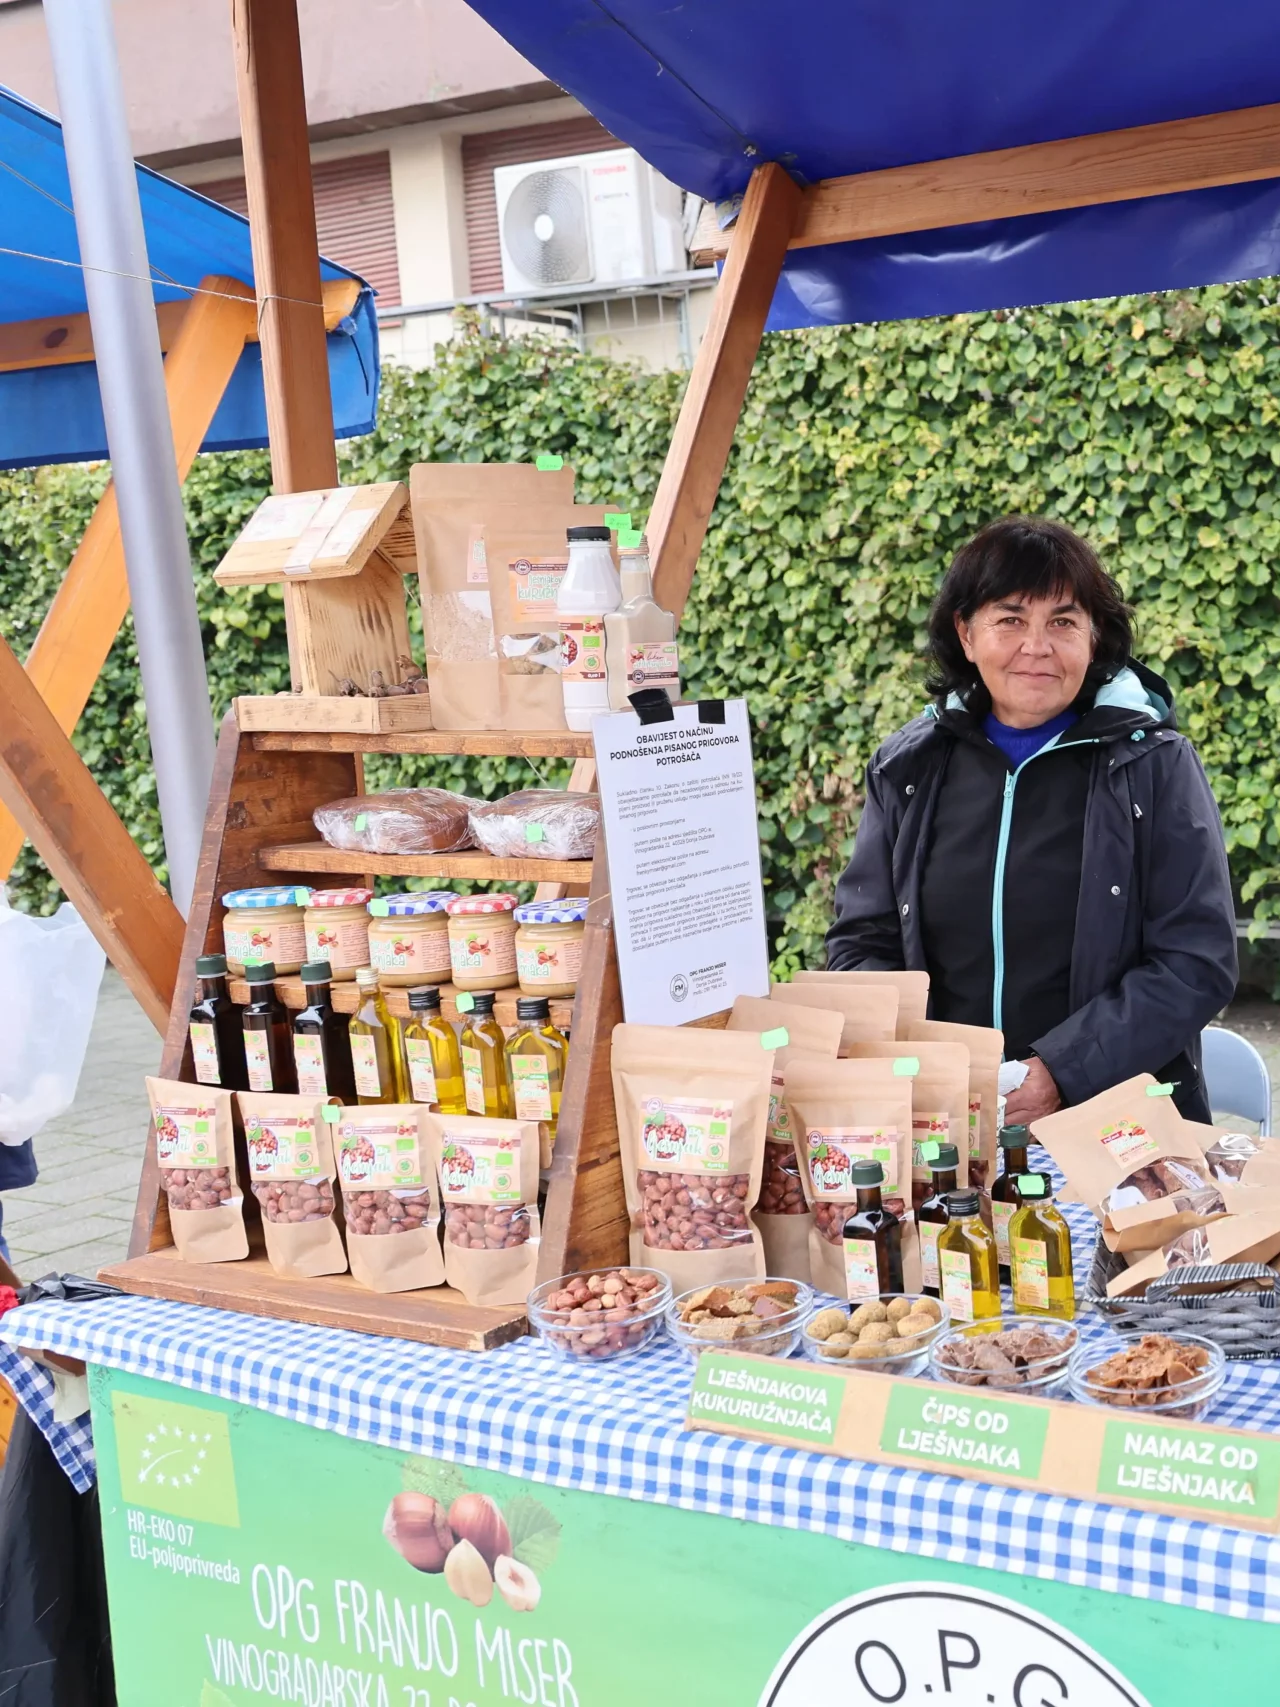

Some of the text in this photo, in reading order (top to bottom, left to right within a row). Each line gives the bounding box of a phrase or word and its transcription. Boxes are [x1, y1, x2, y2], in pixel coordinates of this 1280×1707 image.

[610, 735, 740, 761] PODNOŠENJA PISANOG PRIGOVORA
[636, 726, 714, 744] OBAVIJEST O NAČINU
[656, 752, 702, 766] POTROŠAČA
[707, 1367, 828, 1407] LJEŠNJAKOVA
[692, 1391, 832, 1435] KUKURUŽNJAČA
[922, 1396, 1009, 1435] ČIPS OD
[897, 1427, 1021, 1470] LJEŠNJAKA
[1124, 1432, 1258, 1471] NAMAZ OD
[1117, 1464, 1256, 1506] LJEŠNJAKA
[127, 1509, 195, 1548] HR-EKO 07
[129, 1535, 241, 1585] EU-poljoprivreda
[250, 1562, 581, 1707] OPG FRANJO MISER
[205, 1633, 390, 1707] VINOGRADARSKA
